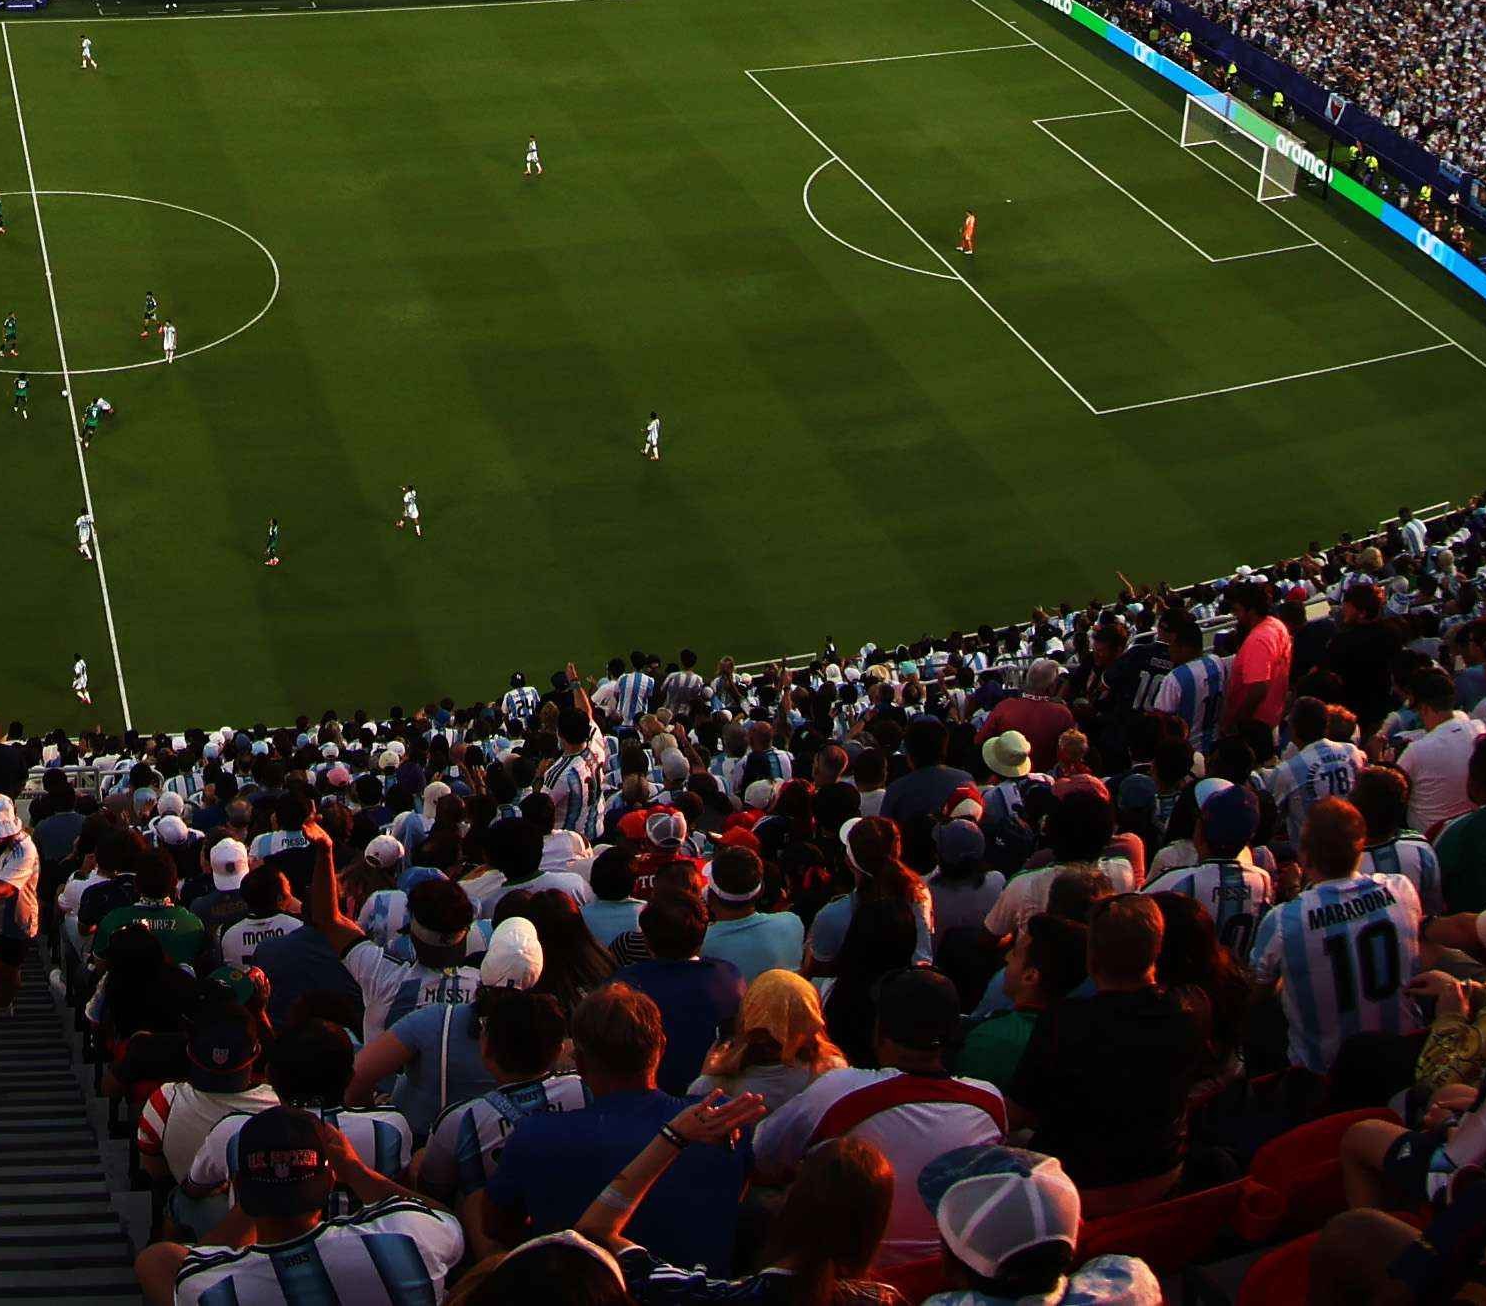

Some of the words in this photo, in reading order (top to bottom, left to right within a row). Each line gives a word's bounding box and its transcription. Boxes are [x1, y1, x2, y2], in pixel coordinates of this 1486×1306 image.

[1276, 132, 1333, 184] aramco
[1318, 765, 1351, 796] 78
[1307, 890, 1397, 930] MARADONA
[1322, 921, 1401, 1014] 10
[425, 989, 474, 1006] MESSI
